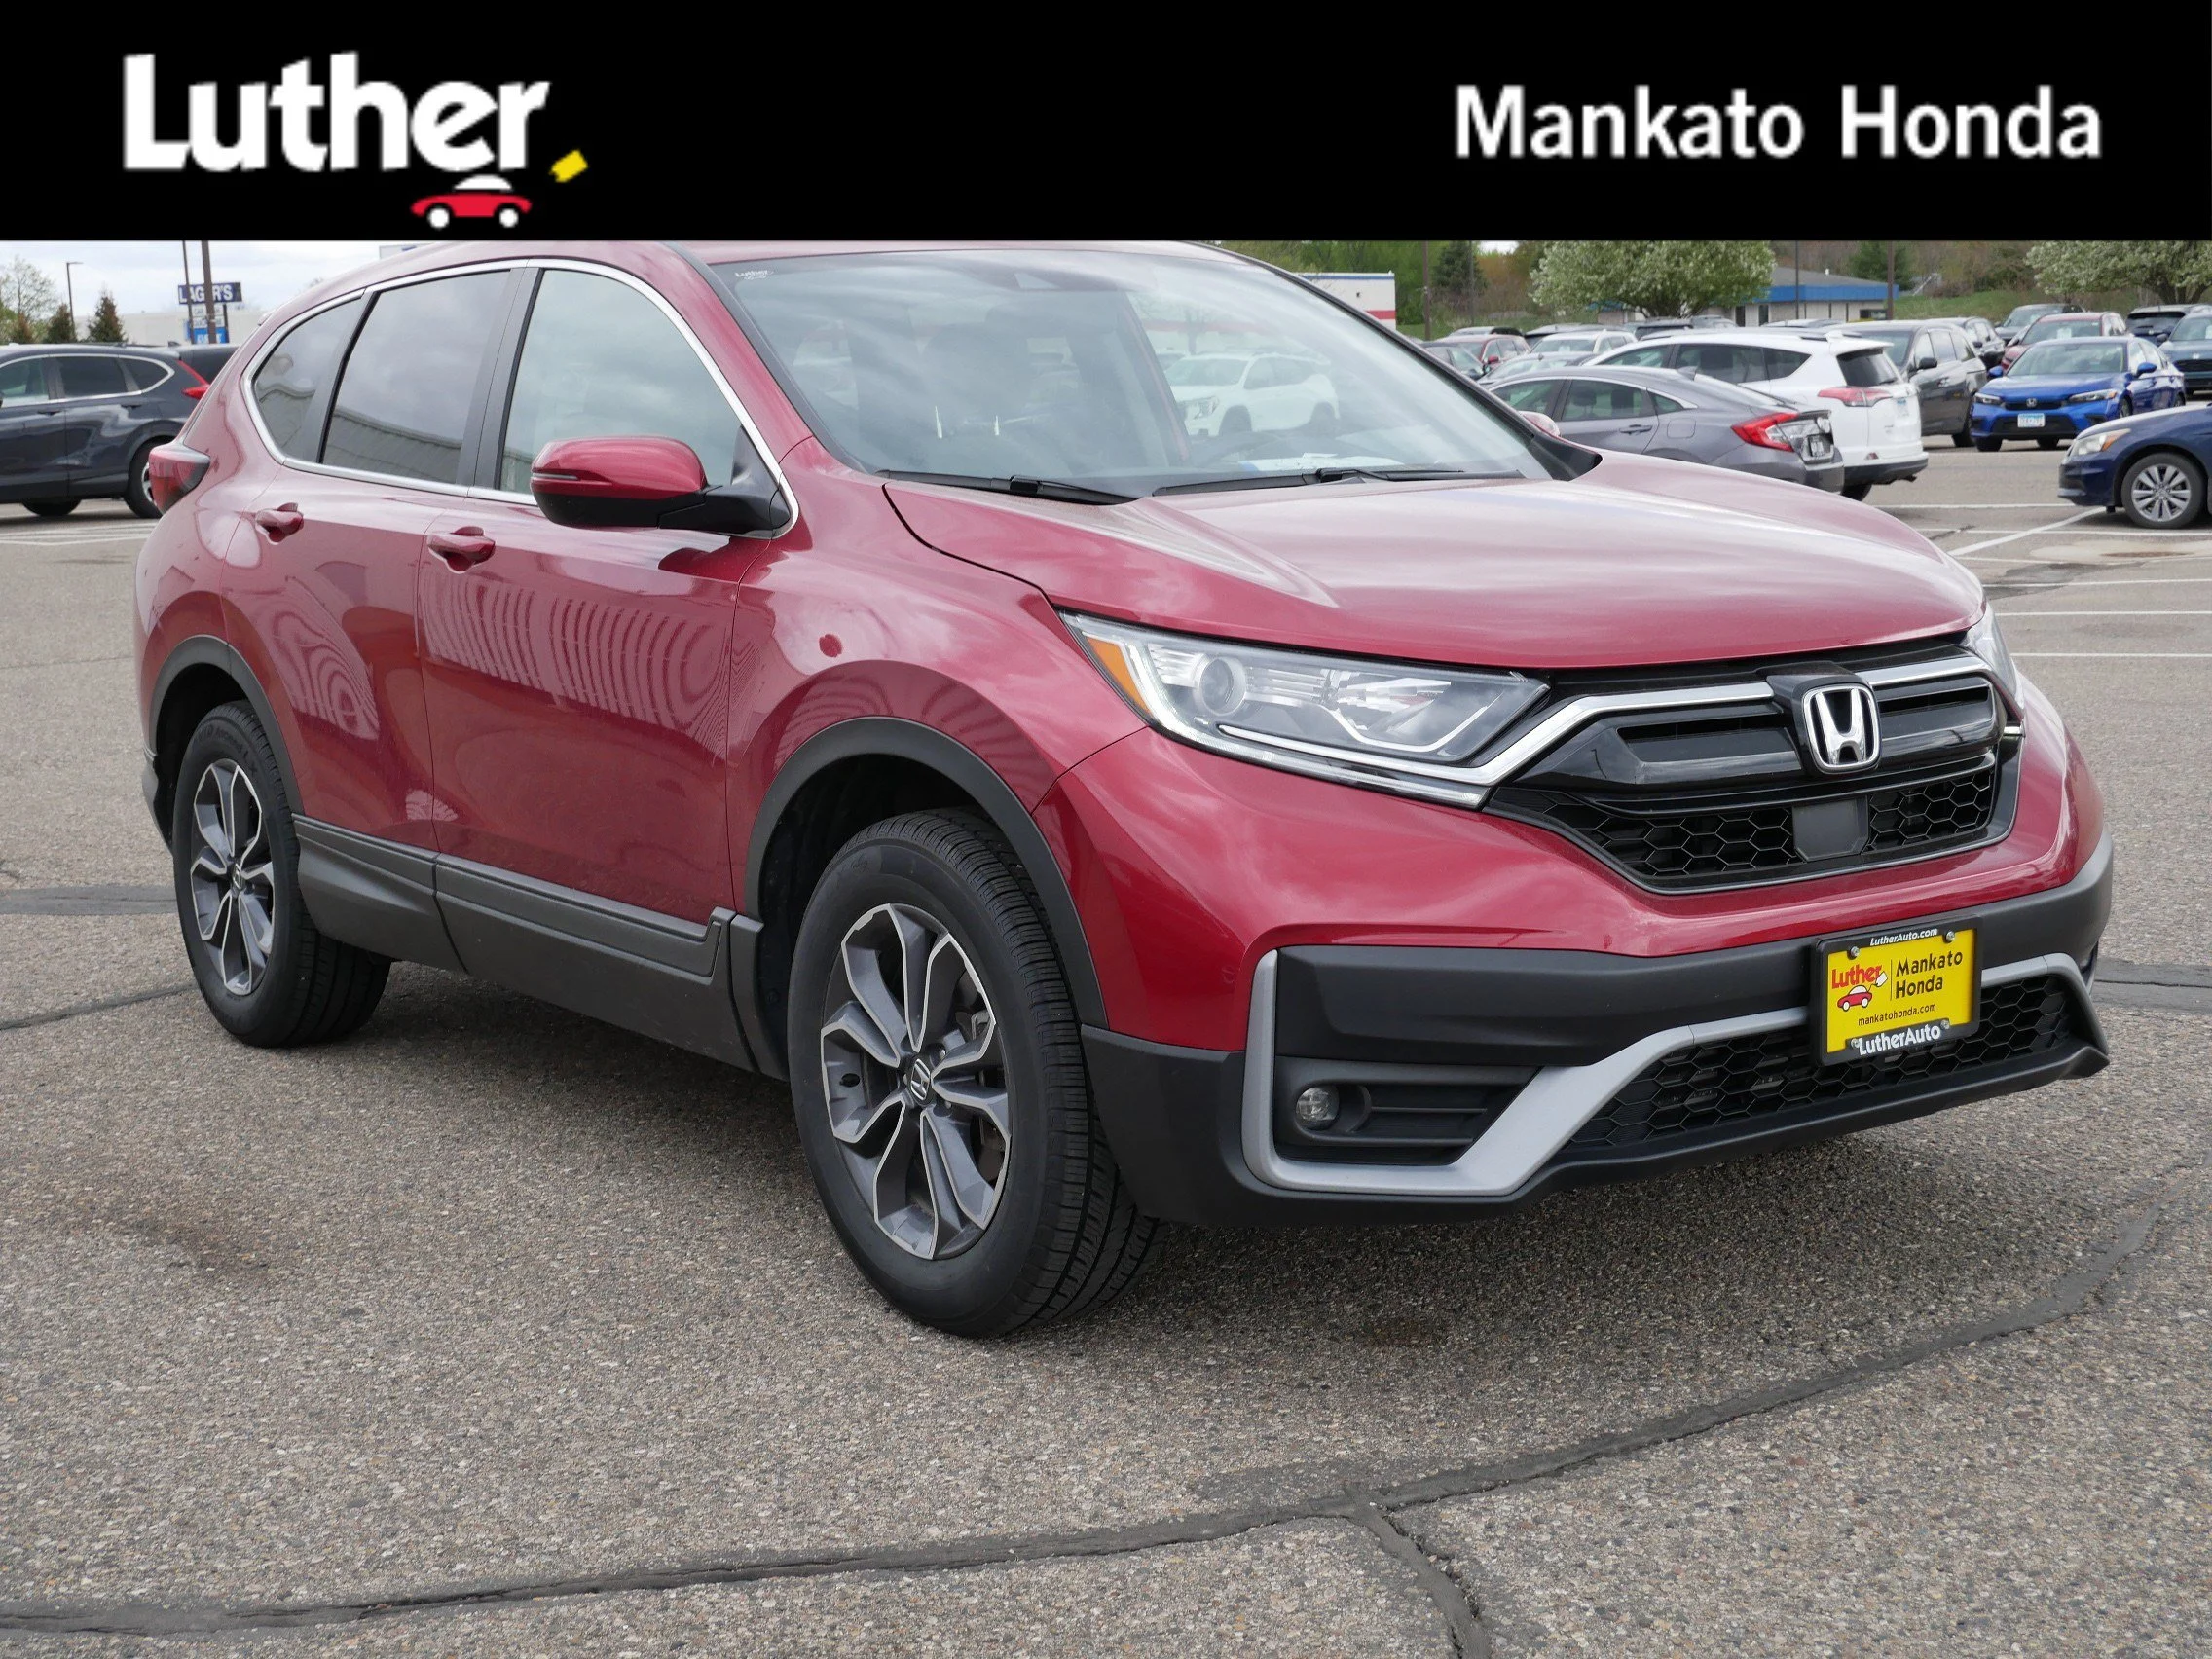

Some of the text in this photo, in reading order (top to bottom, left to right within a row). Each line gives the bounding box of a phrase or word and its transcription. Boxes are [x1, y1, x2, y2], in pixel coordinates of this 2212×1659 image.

[178, 284, 234, 303] LAGR'S
[1869, 928, 1938, 946] LutherAuto.com
[1895, 950, 1964, 977] Mankato
[1831, 963, 1883, 990] Luther
[1895, 975, 1943, 999] Honda
[1858, 1003, 1936, 1026] mankatohonda.com
[1858, 1023, 1941, 1056] LutherAuto
